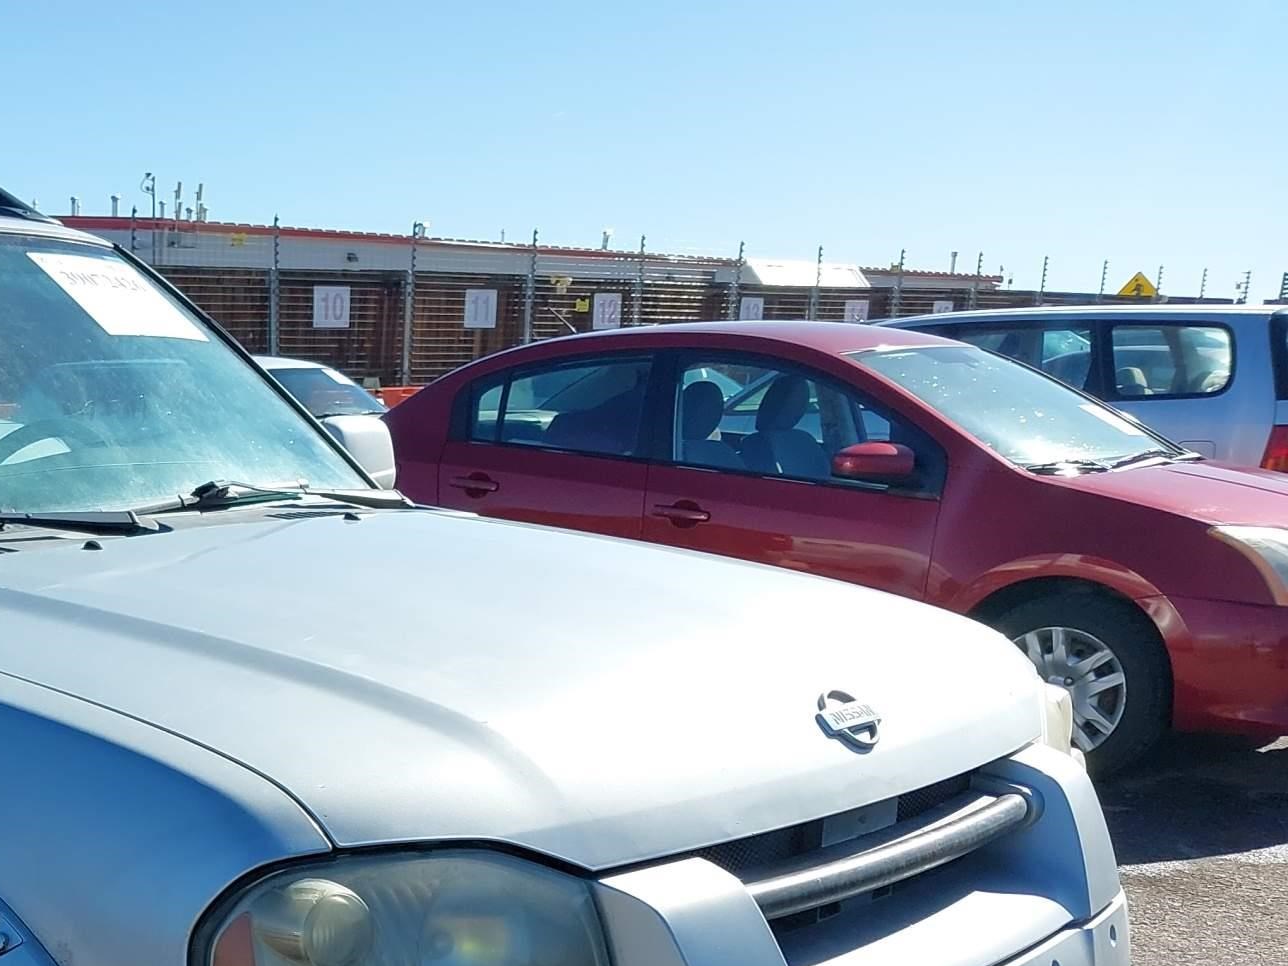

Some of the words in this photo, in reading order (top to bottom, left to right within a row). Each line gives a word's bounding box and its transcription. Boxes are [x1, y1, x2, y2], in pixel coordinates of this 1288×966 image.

[320, 292, 345, 321] 10
[471, 295, 491, 322] 11
[599, 298, 618, 324] 12
[829, 703, 876, 726] NISSAN
